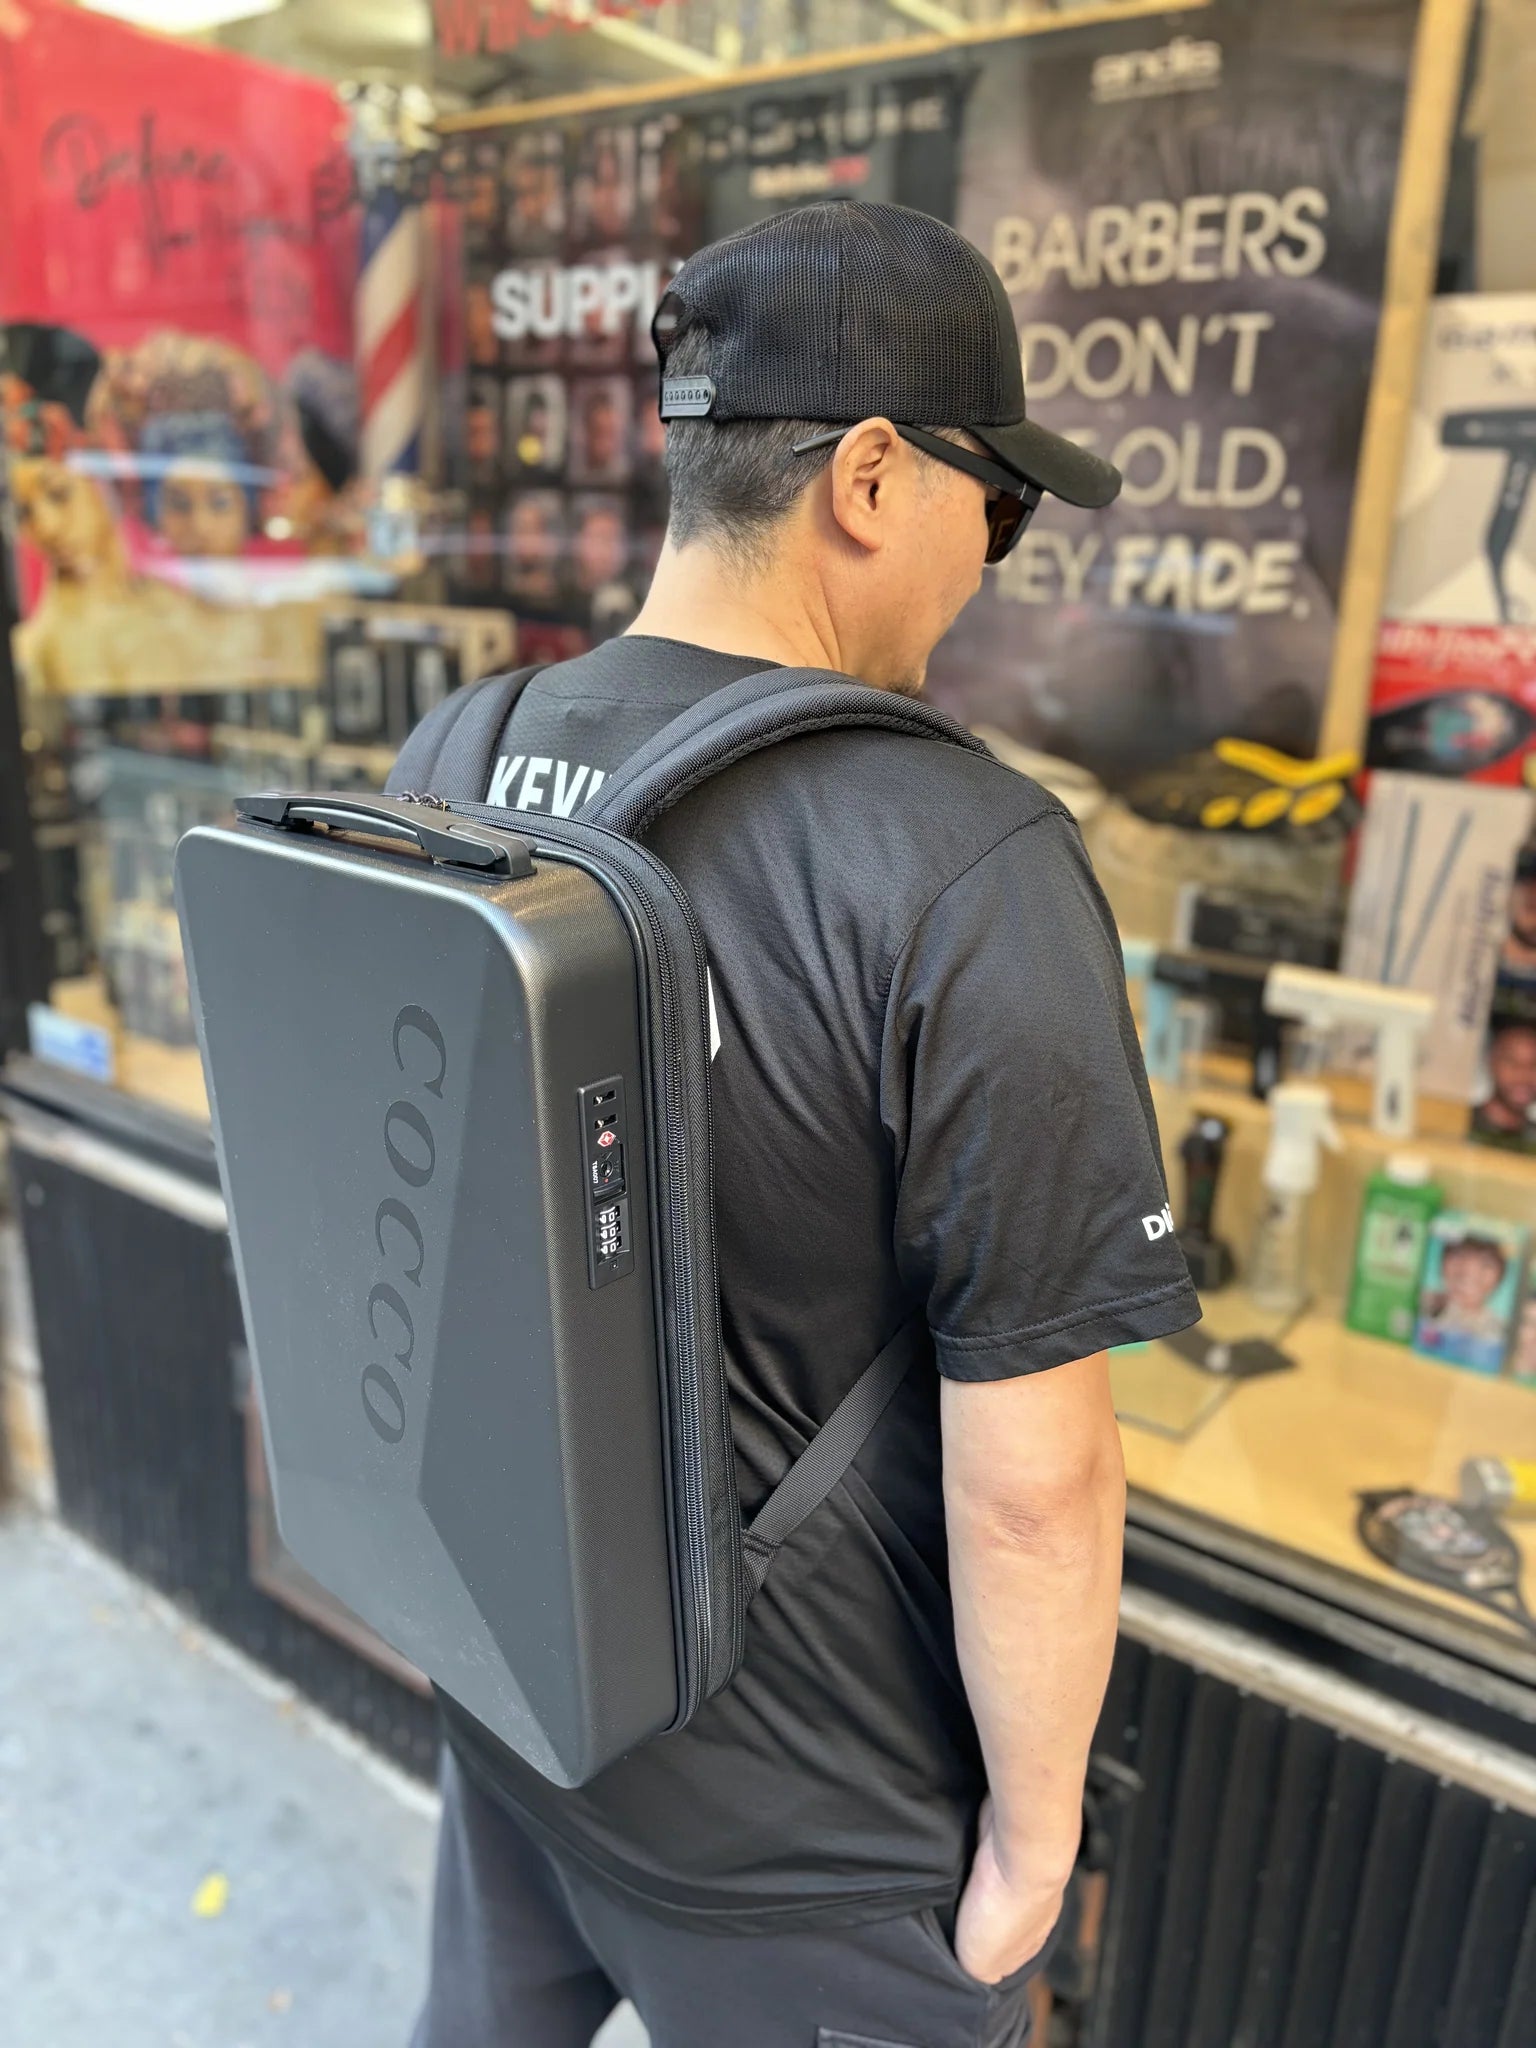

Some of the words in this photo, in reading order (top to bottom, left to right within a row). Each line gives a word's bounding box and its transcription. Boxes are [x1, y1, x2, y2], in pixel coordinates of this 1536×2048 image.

[993, 187, 1328, 296] BARBERS
[491, 257, 684, 340] SUPPL
[1021, 311, 1274, 399] DON'T
[1110, 422, 1302, 510] OLD.
[1107, 532, 1310, 621] FADE.
[360, 1003, 447, 1444] COCCO
